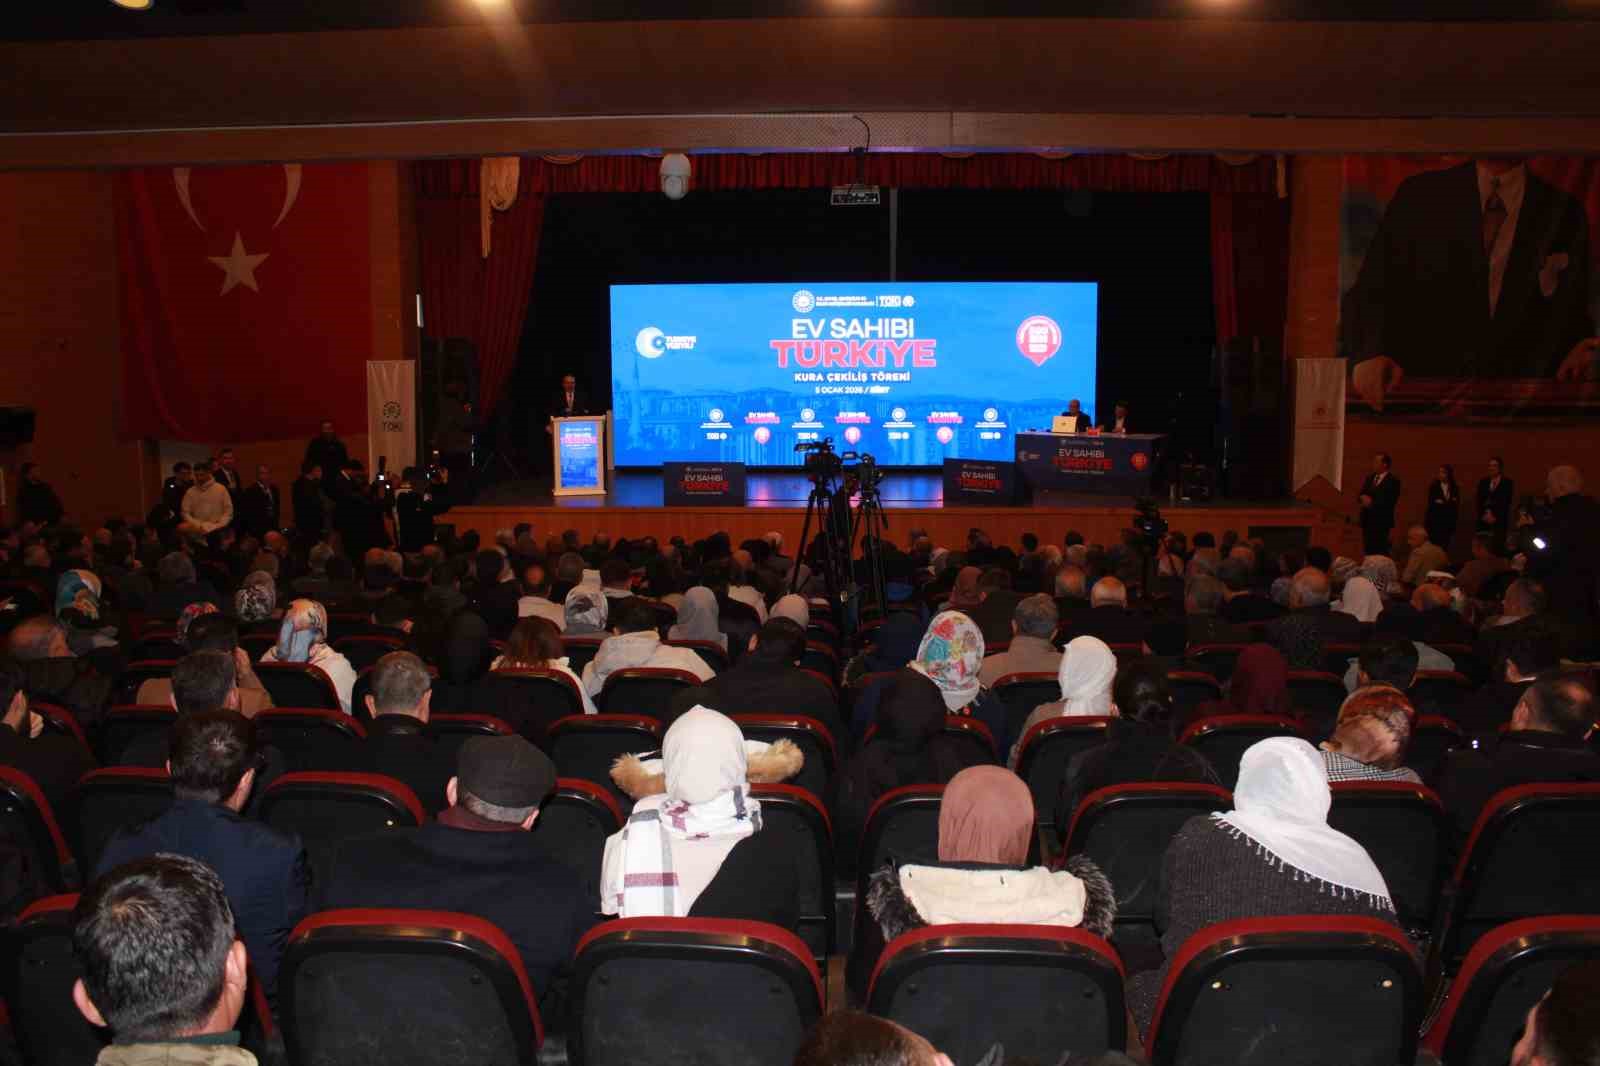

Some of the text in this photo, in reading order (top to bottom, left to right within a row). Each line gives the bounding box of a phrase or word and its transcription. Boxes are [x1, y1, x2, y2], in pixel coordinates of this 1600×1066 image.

[792, 318, 825, 339] EV
[794, 371, 911, 383] KURA ÇEKİLİŞ TÖRENİ
[821, 386, 844, 394] OCAK
[1058, 448, 1071, 457] EV
